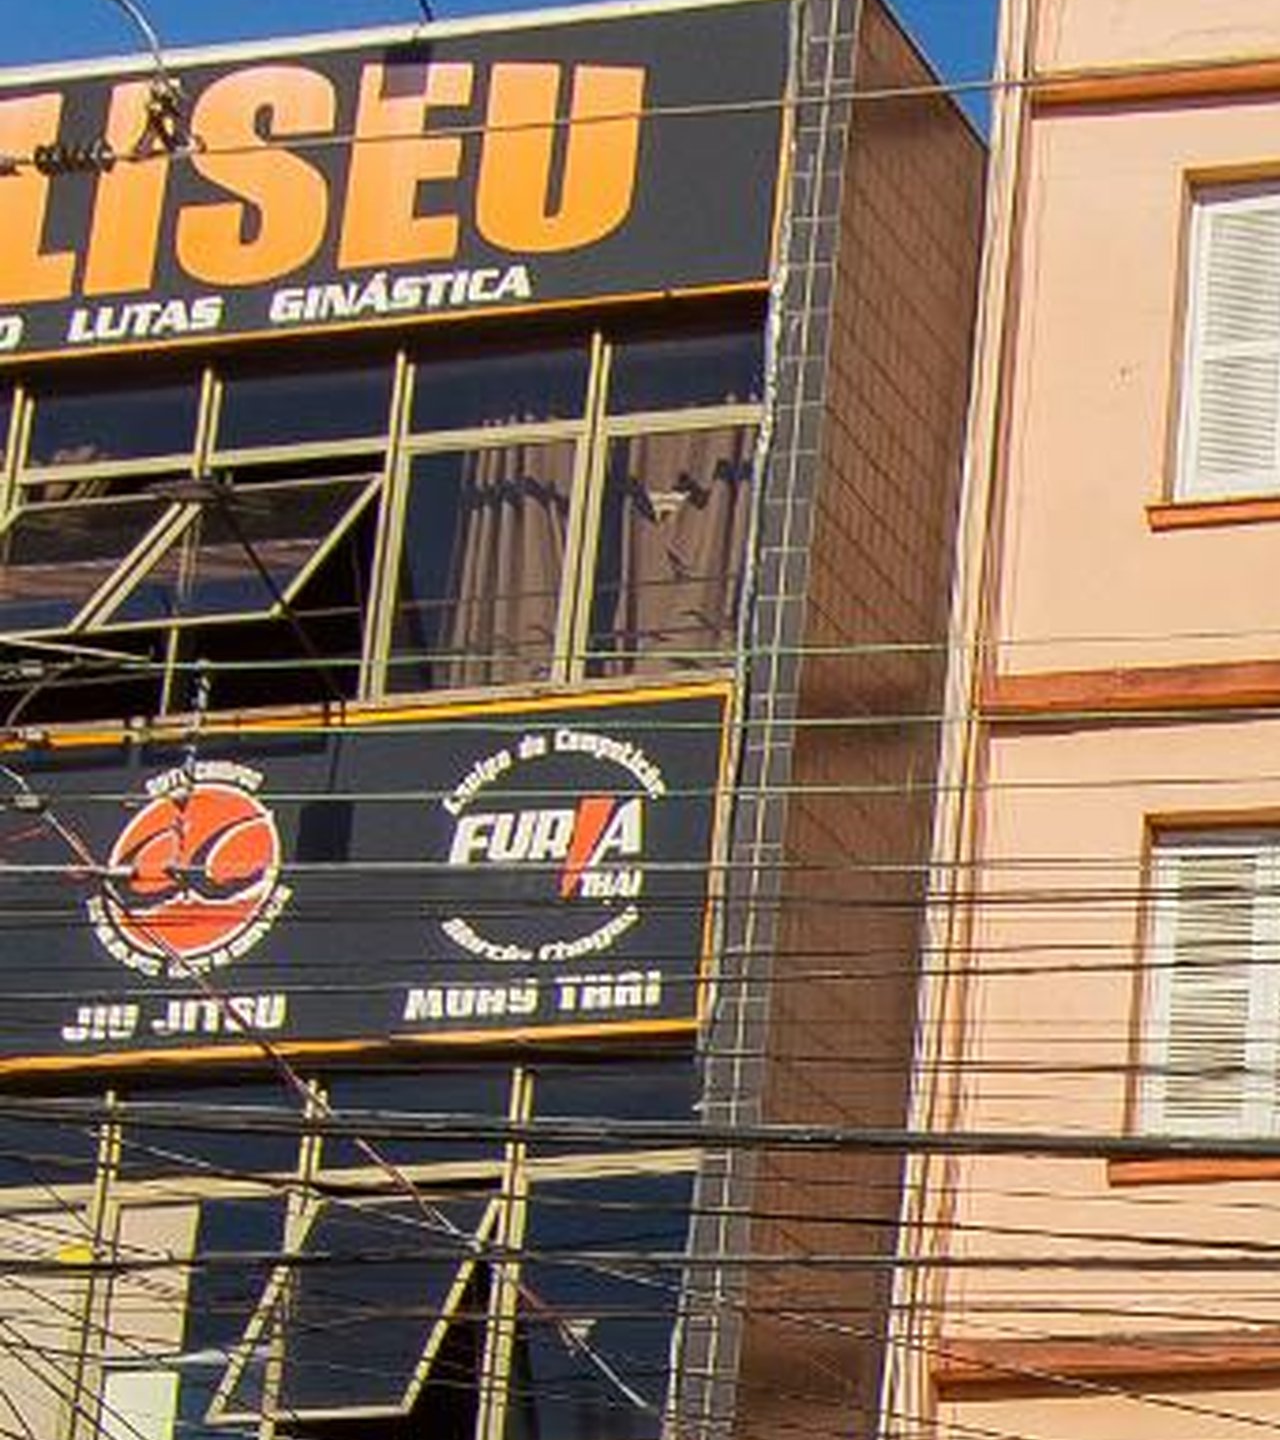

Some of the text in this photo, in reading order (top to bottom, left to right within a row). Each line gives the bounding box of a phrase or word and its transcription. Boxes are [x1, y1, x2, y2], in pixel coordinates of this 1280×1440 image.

[67, 297, 223, 342] LUTAS
[269, 264, 532, 323] GINÁSTICA
[61, 1004, 141, 1041] JIU
